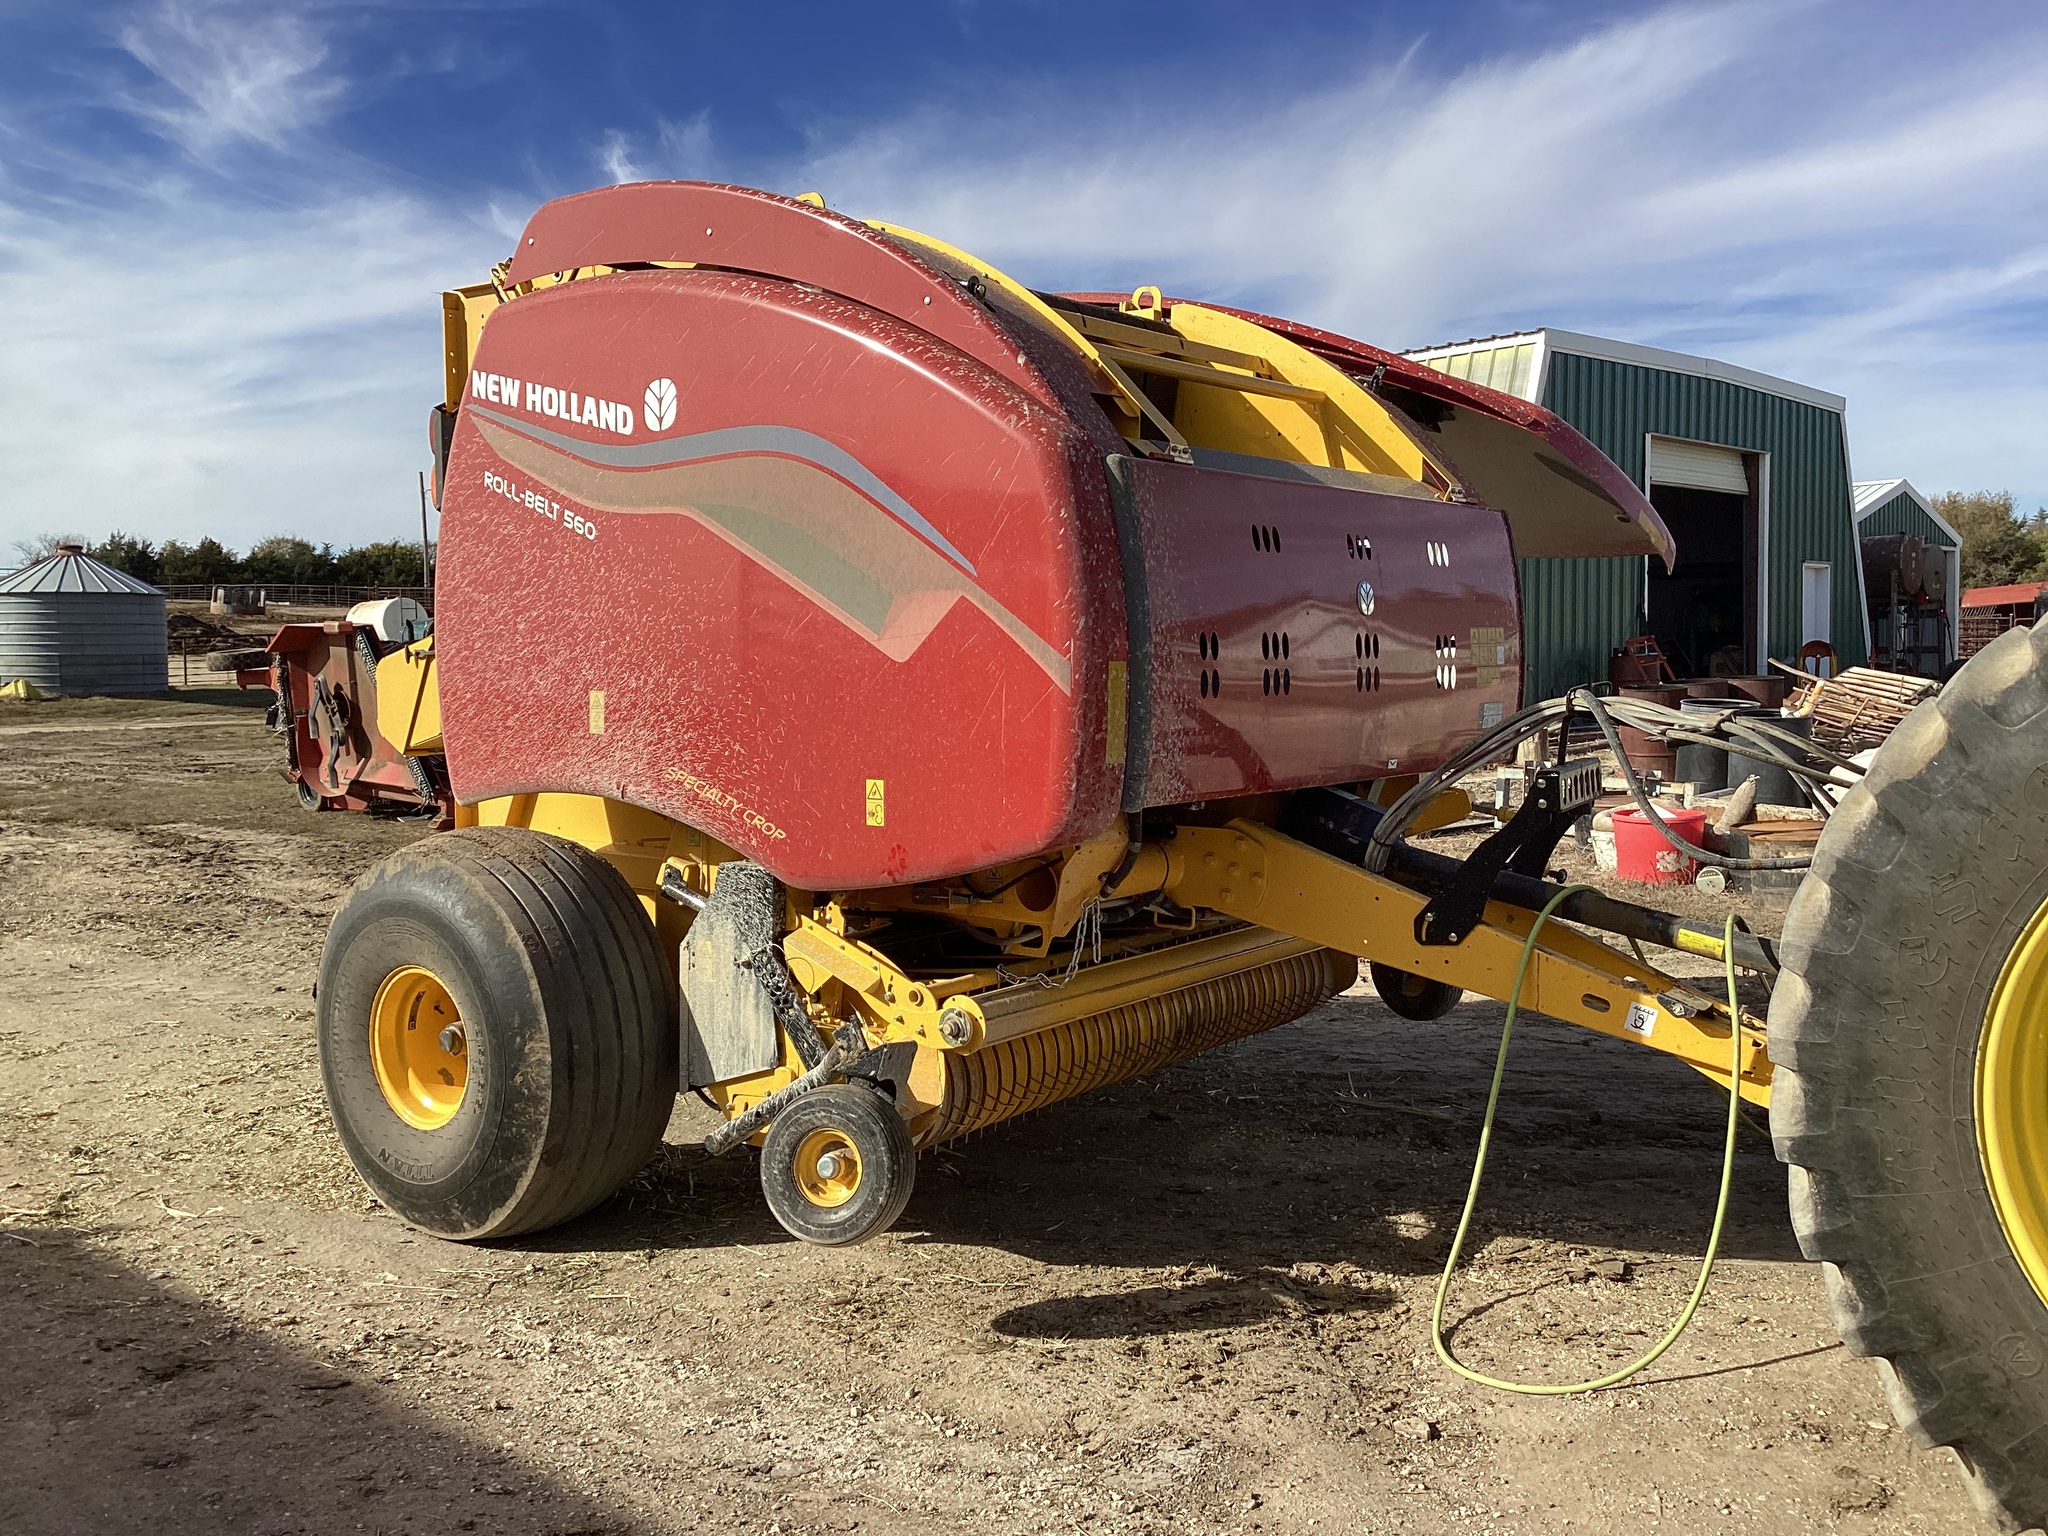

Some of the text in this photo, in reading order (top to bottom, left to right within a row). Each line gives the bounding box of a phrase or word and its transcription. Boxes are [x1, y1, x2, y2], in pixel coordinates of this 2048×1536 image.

[472, 370, 634, 436] NEW HOLLAND
[484, 471, 596, 540] ROLL-BELT 560
[665, 766, 786, 840] SPECIALTY CROP
[378, 1148, 434, 1181] TITAN
